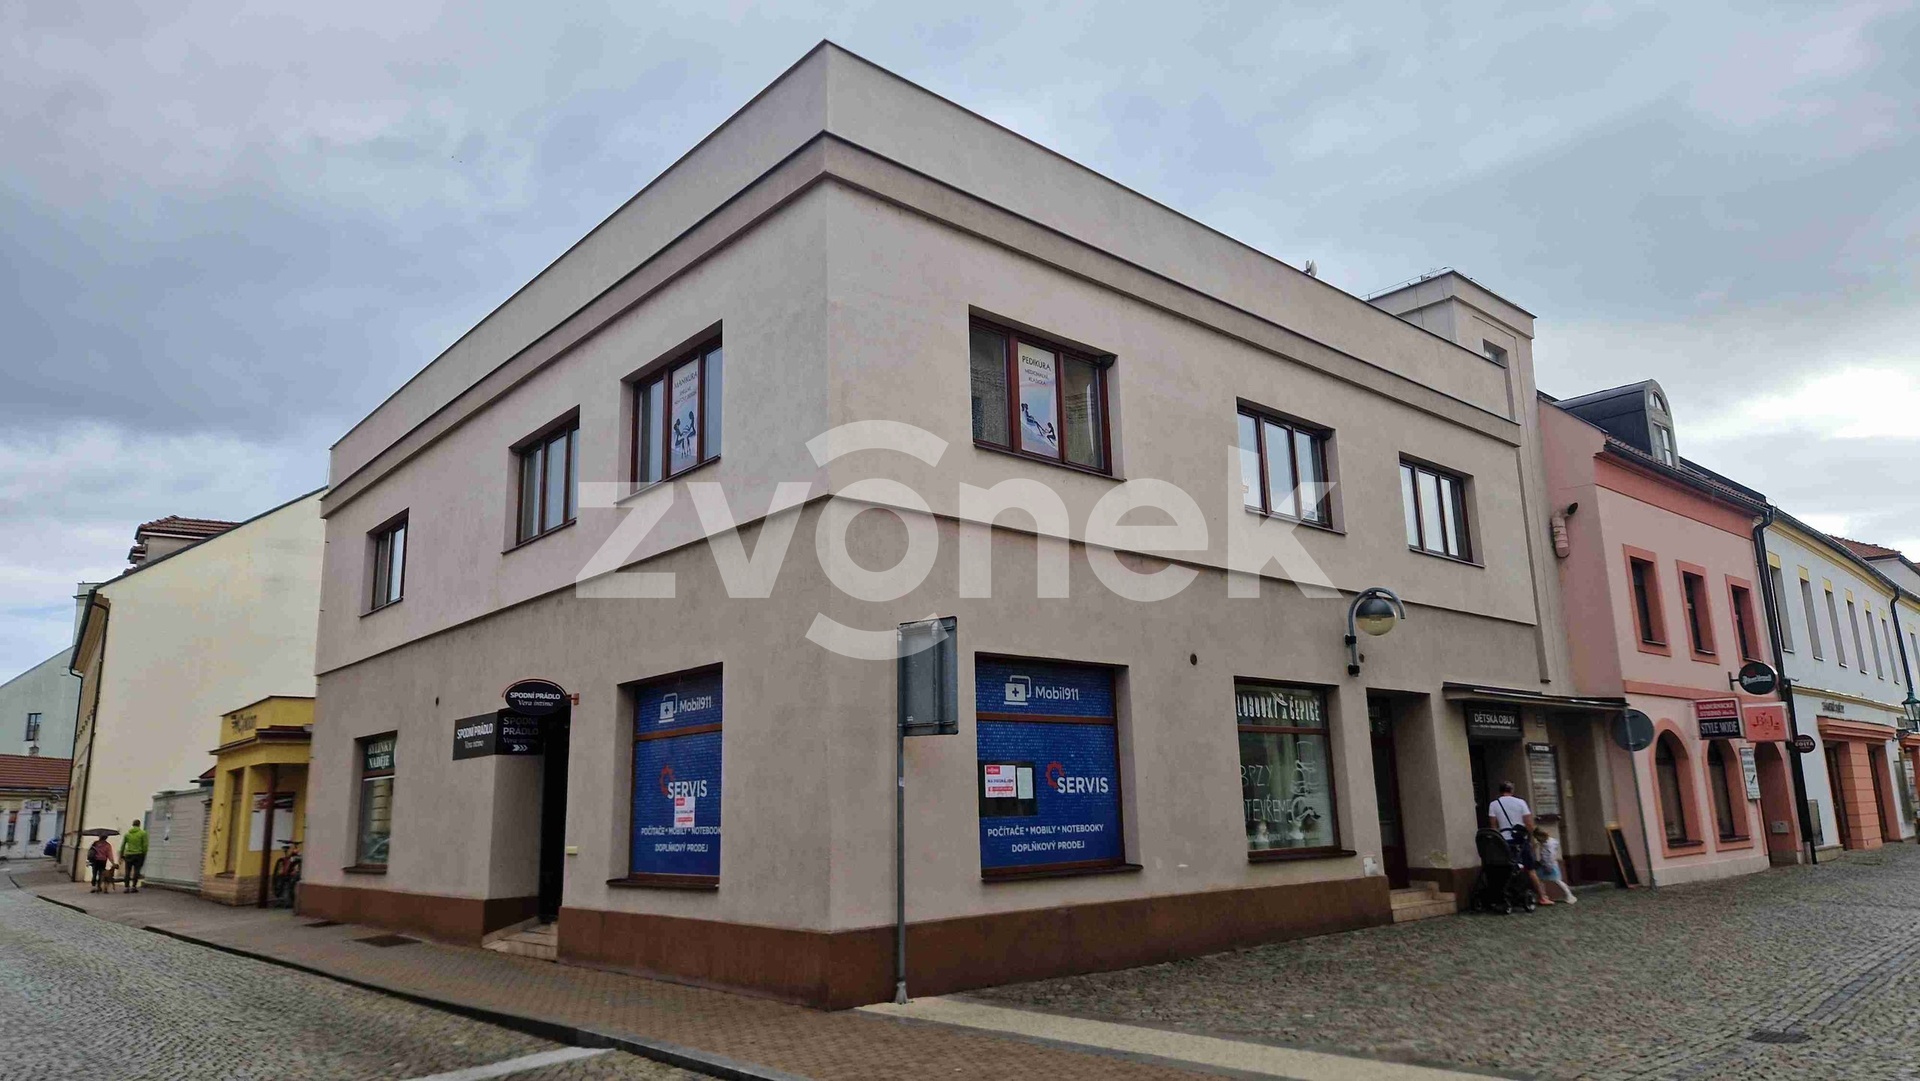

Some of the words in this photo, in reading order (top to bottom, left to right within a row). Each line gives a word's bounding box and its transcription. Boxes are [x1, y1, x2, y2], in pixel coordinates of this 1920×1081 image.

[510, 691, 534, 699] SPODNÍ
[535, 691, 560, 700] PRÁDLO
[1035, 686, 1079, 701] Mobil911
[679, 695, 712, 713] Mobil911
[1237, 694, 1278, 719] LOBOUKY
[457, 724, 474, 740] SPODNÍ
[474, 722, 493, 736] PRÁDLO
[667, 780, 707, 799] SERVIS
[1057, 777, 1109, 793] SERVIS
[641, 825, 665, 836] POČÍTAČE
[987, 824, 1025, 837] POČÍTAČE
[1030, 824, 1056, 835] MOBILY
[1061, 823, 1104, 834] NOTEBOOKY
[686, 843, 708, 853] PRODEJ
[1011, 840, 1056, 853] DOPLŇKOVÝ
[1058, 840, 1085, 850] PRODEJ
